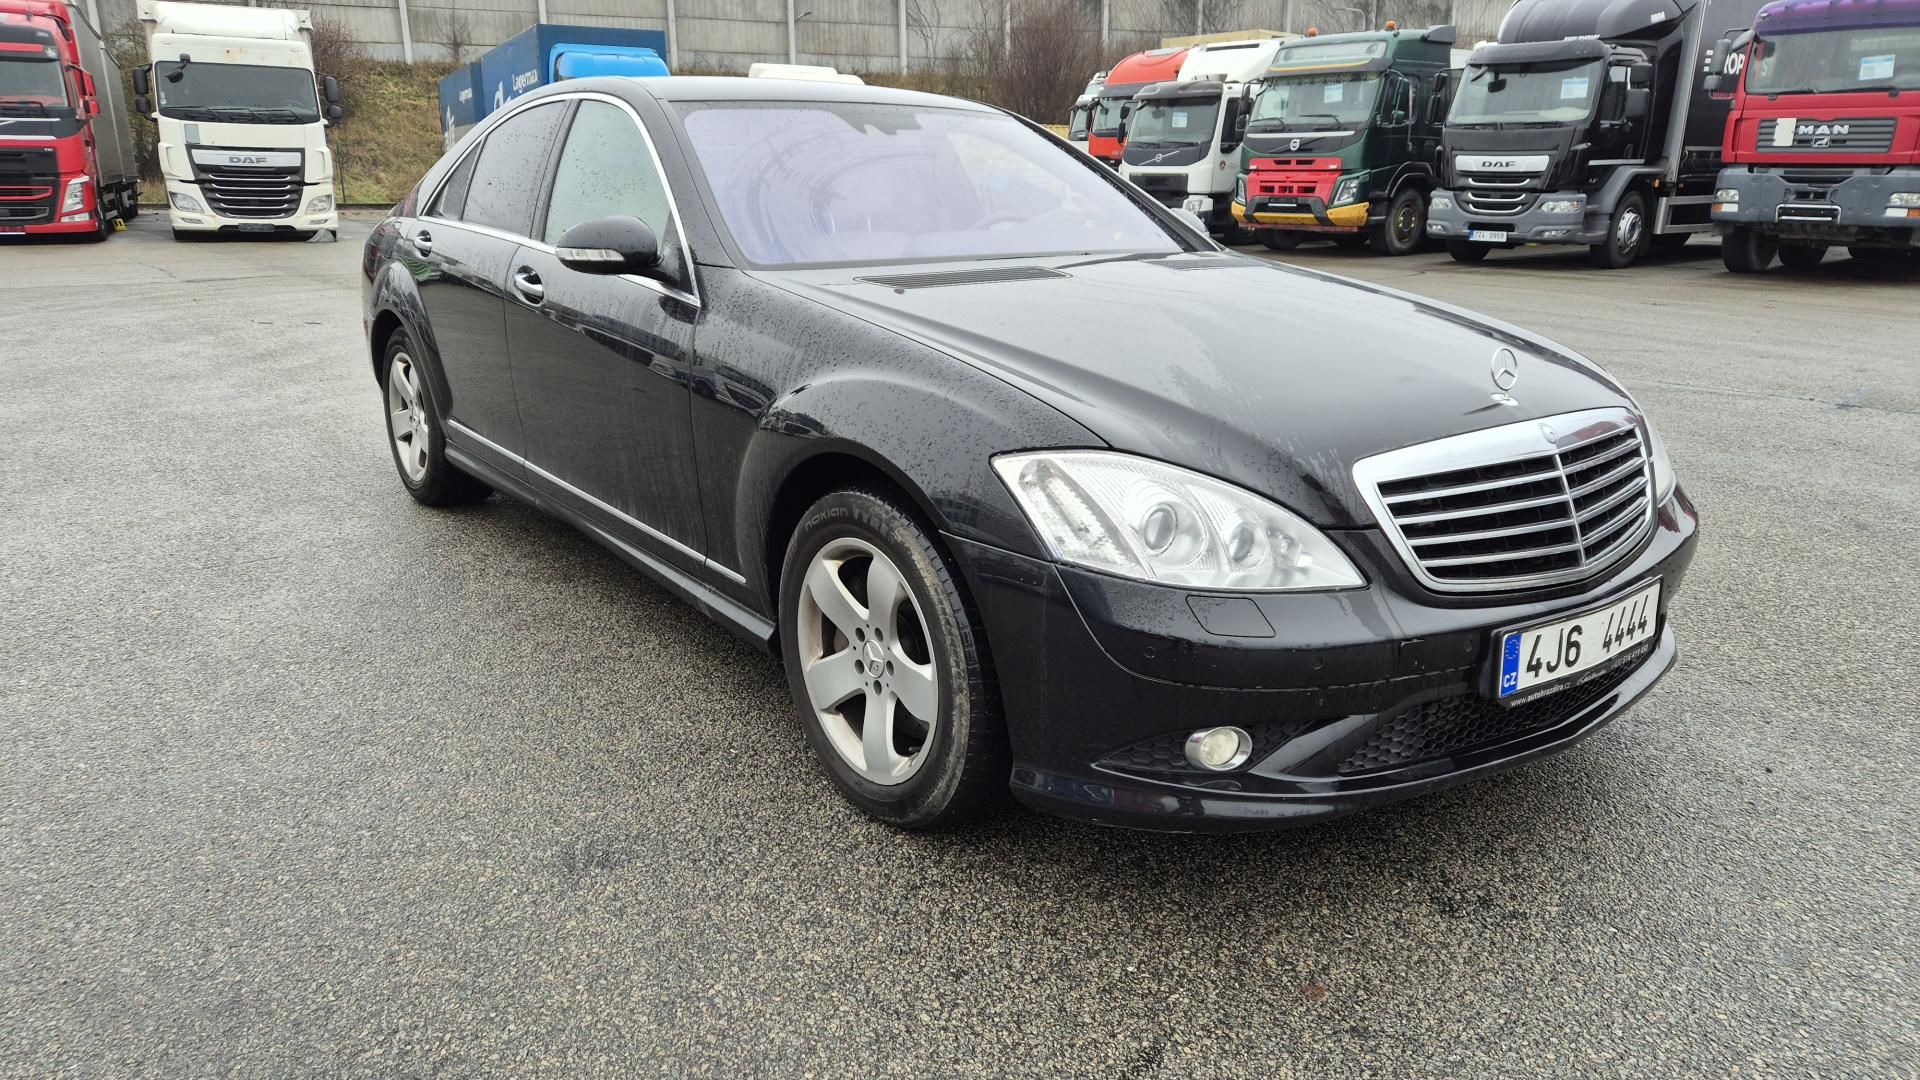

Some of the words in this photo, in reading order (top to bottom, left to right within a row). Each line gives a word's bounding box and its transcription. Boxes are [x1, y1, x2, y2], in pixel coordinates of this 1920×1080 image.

[1798, 124, 1850, 135] MAN
[228, 156, 268, 164] DAF
[1481, 160, 1516, 168] DAF
[1526, 624, 1584, 678] 4J6
[1602, 594, 1649, 653] 4444
[1503, 671, 1517, 689] CZ
